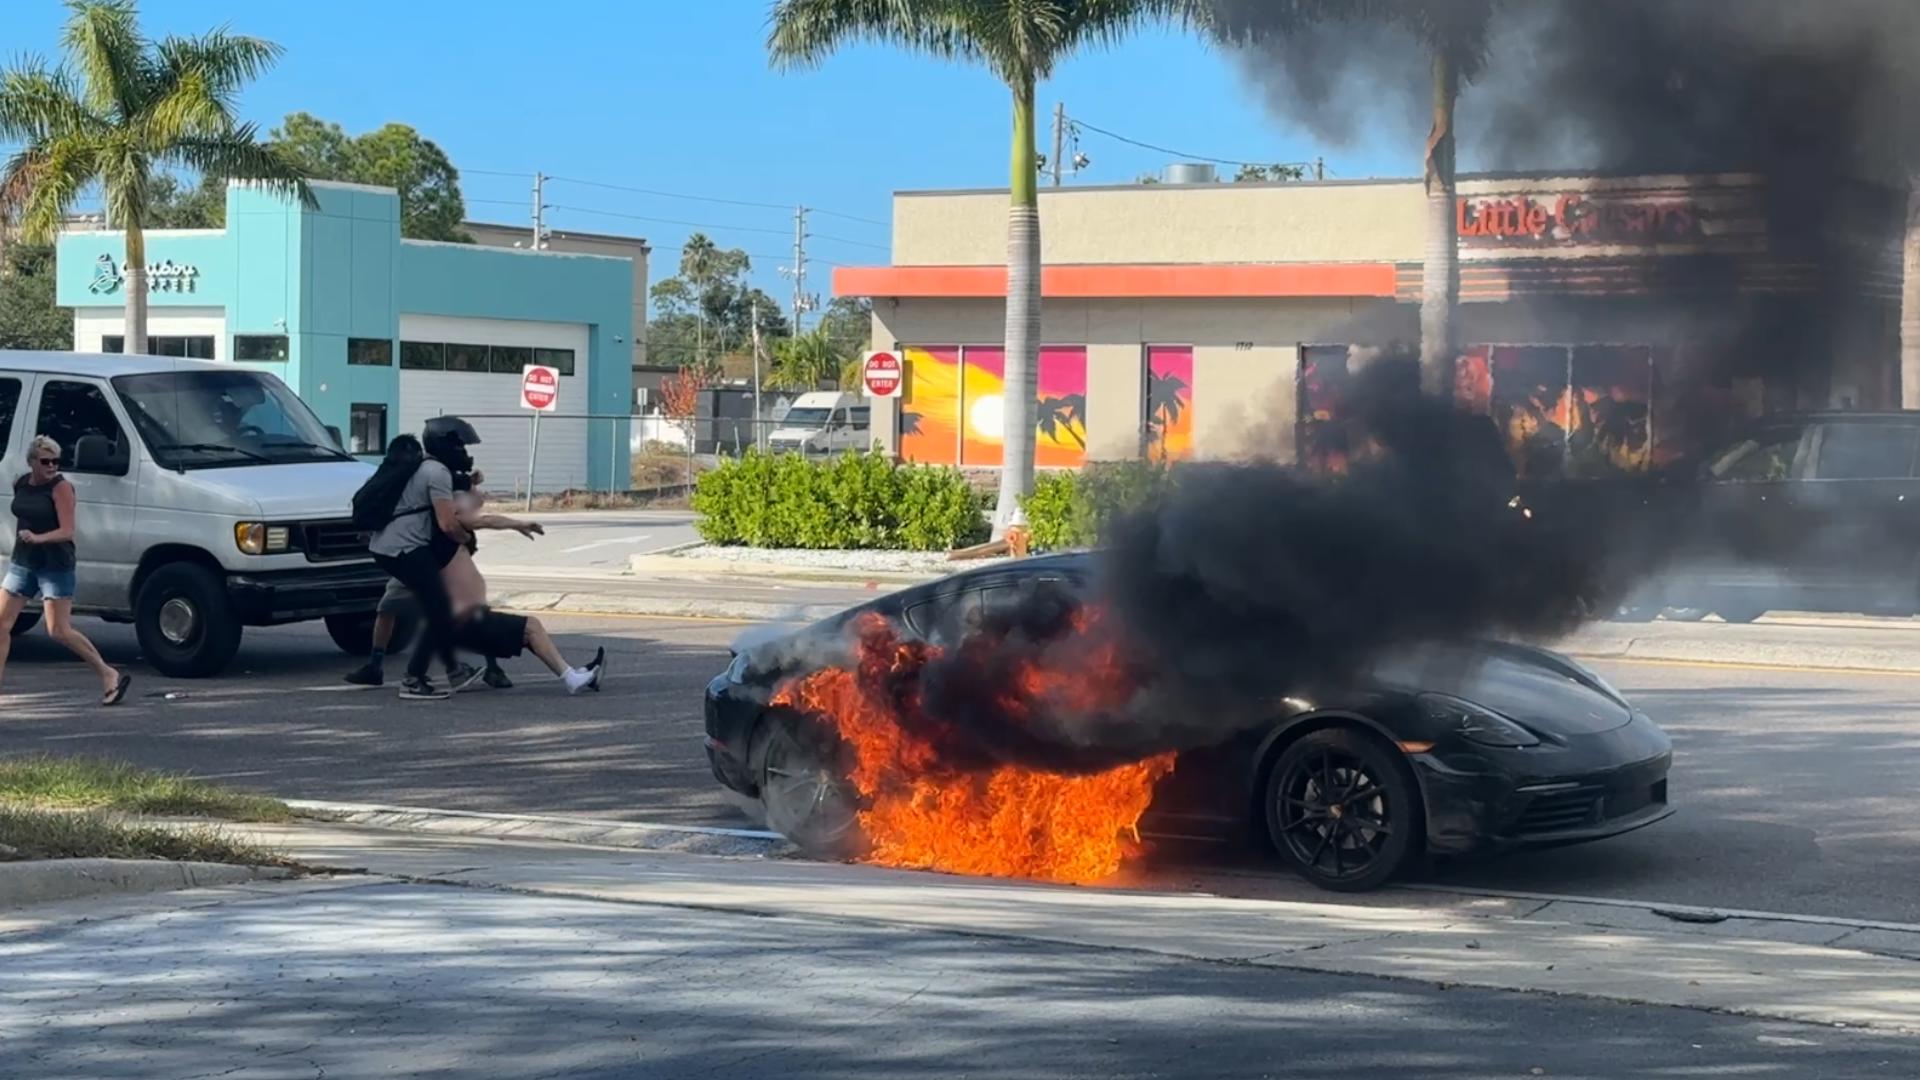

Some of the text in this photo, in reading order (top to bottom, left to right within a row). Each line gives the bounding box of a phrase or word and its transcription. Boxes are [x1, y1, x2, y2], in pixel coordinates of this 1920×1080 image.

[1456, 192, 1694, 236] Little Casars
[119, 259, 195, 277] Cribou
[868, 360, 896, 368] DO NOT
[871, 379, 894, 388] ENTER
